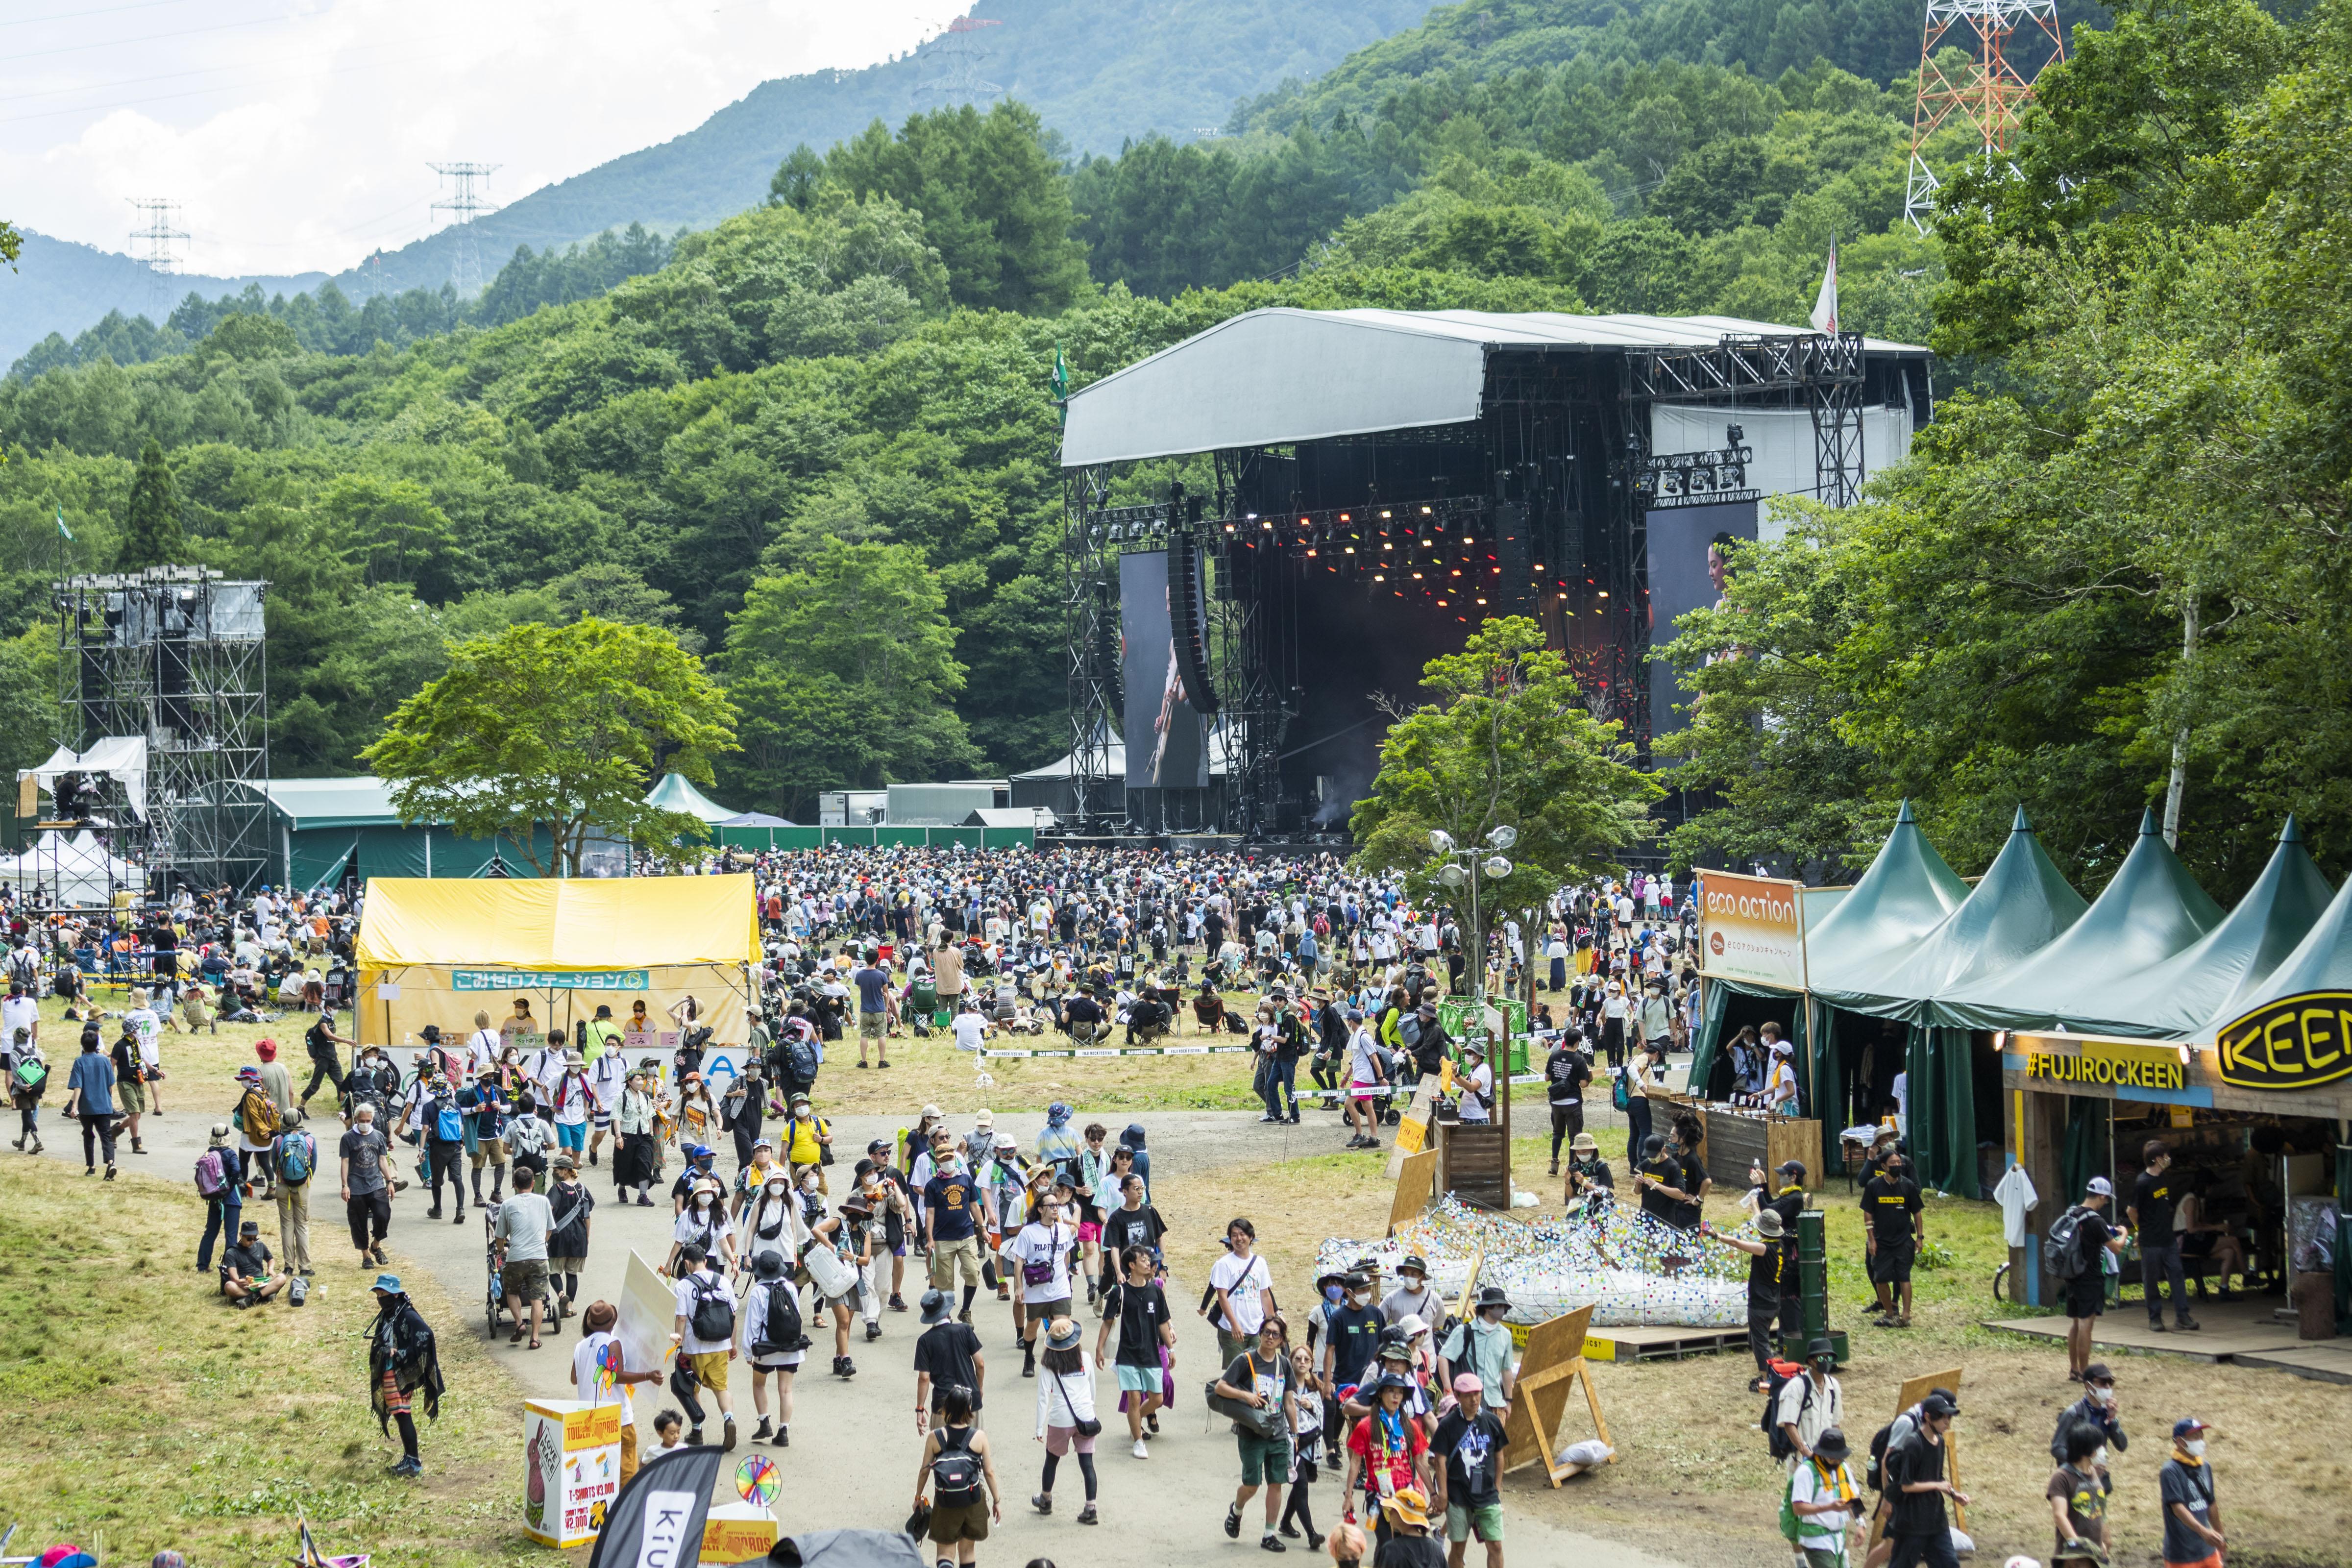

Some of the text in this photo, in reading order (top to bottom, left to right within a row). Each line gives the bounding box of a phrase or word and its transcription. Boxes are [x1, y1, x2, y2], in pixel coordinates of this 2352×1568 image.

[1708, 891, 1794, 925] eco action
[1121, 956, 1132, 972] 18
[457, 973, 621, 988] ごみゼロステーション
[2025, 1053, 2183, 1089] #FUJIROCKEEN
[1034, 1244, 1047, 1252] PULP
[539, 1439, 555, 1473] PEACE
[544, 1434, 557, 1463] LOVE
[569, 1486, 595, 1501] T-SHIRTS
